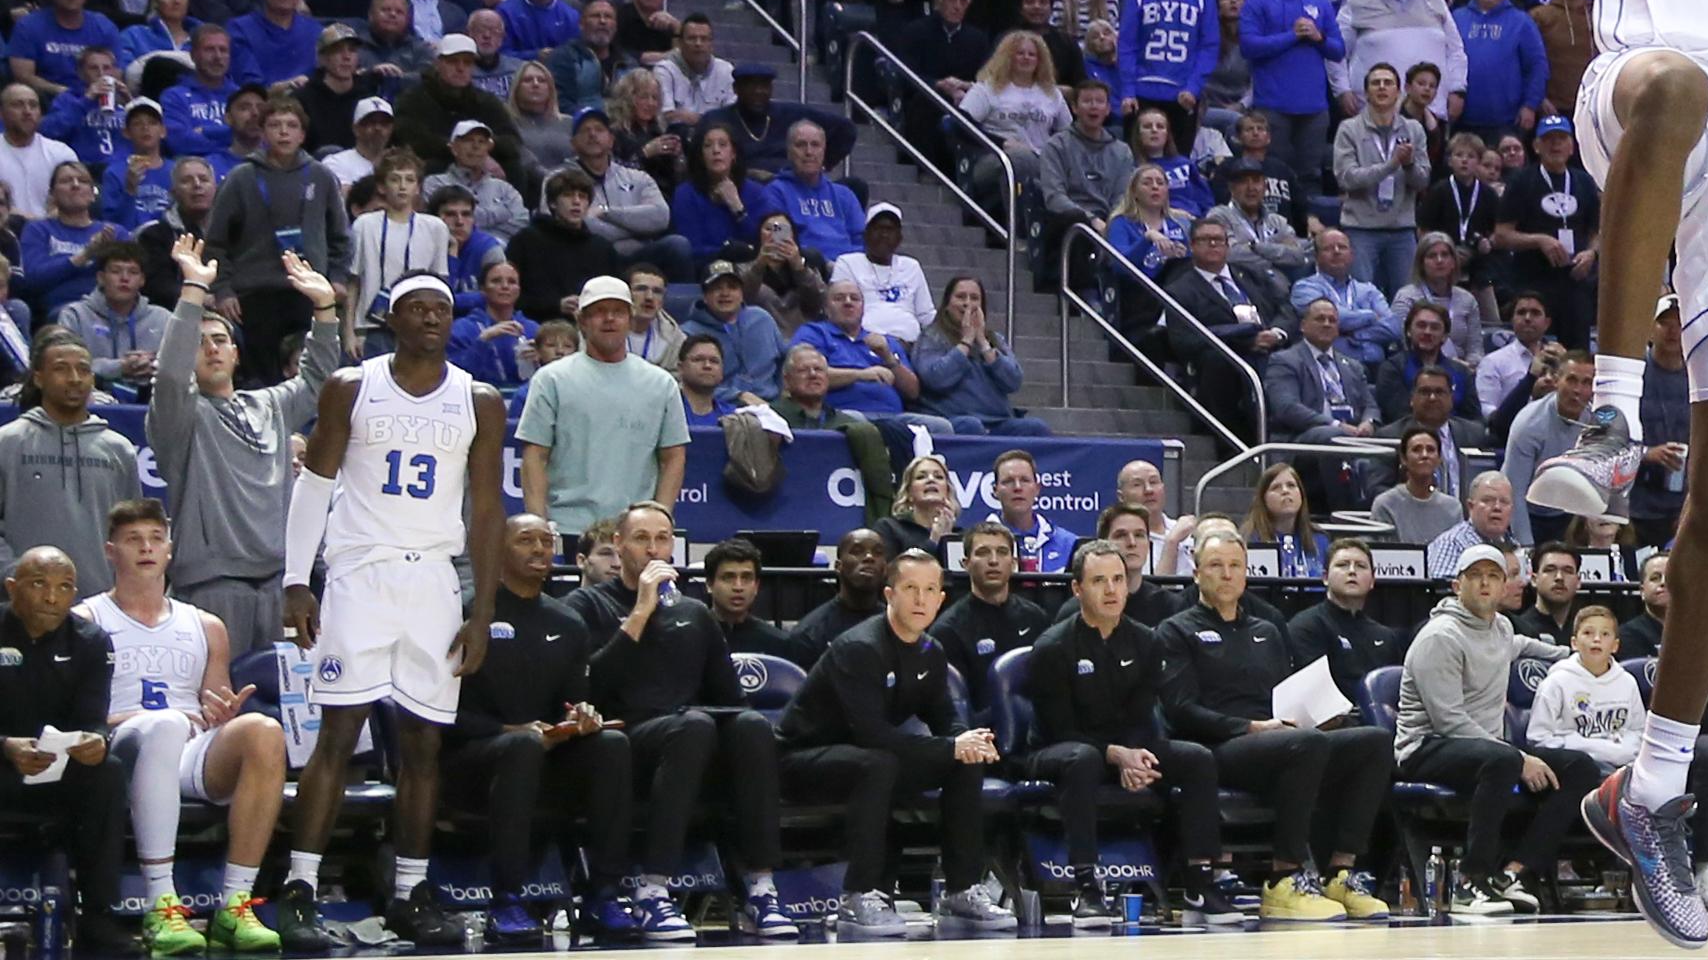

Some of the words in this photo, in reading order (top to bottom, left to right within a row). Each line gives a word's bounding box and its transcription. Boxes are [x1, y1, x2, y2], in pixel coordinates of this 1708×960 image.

[1143, 0, 1199, 27] BYU
[1144, 29, 1189, 63] 25
[366, 415, 460, 453] BYU
[381, 449, 437, 500] 13
[120, 646, 197, 677] BYU
[139, 678, 170, 712] 5
